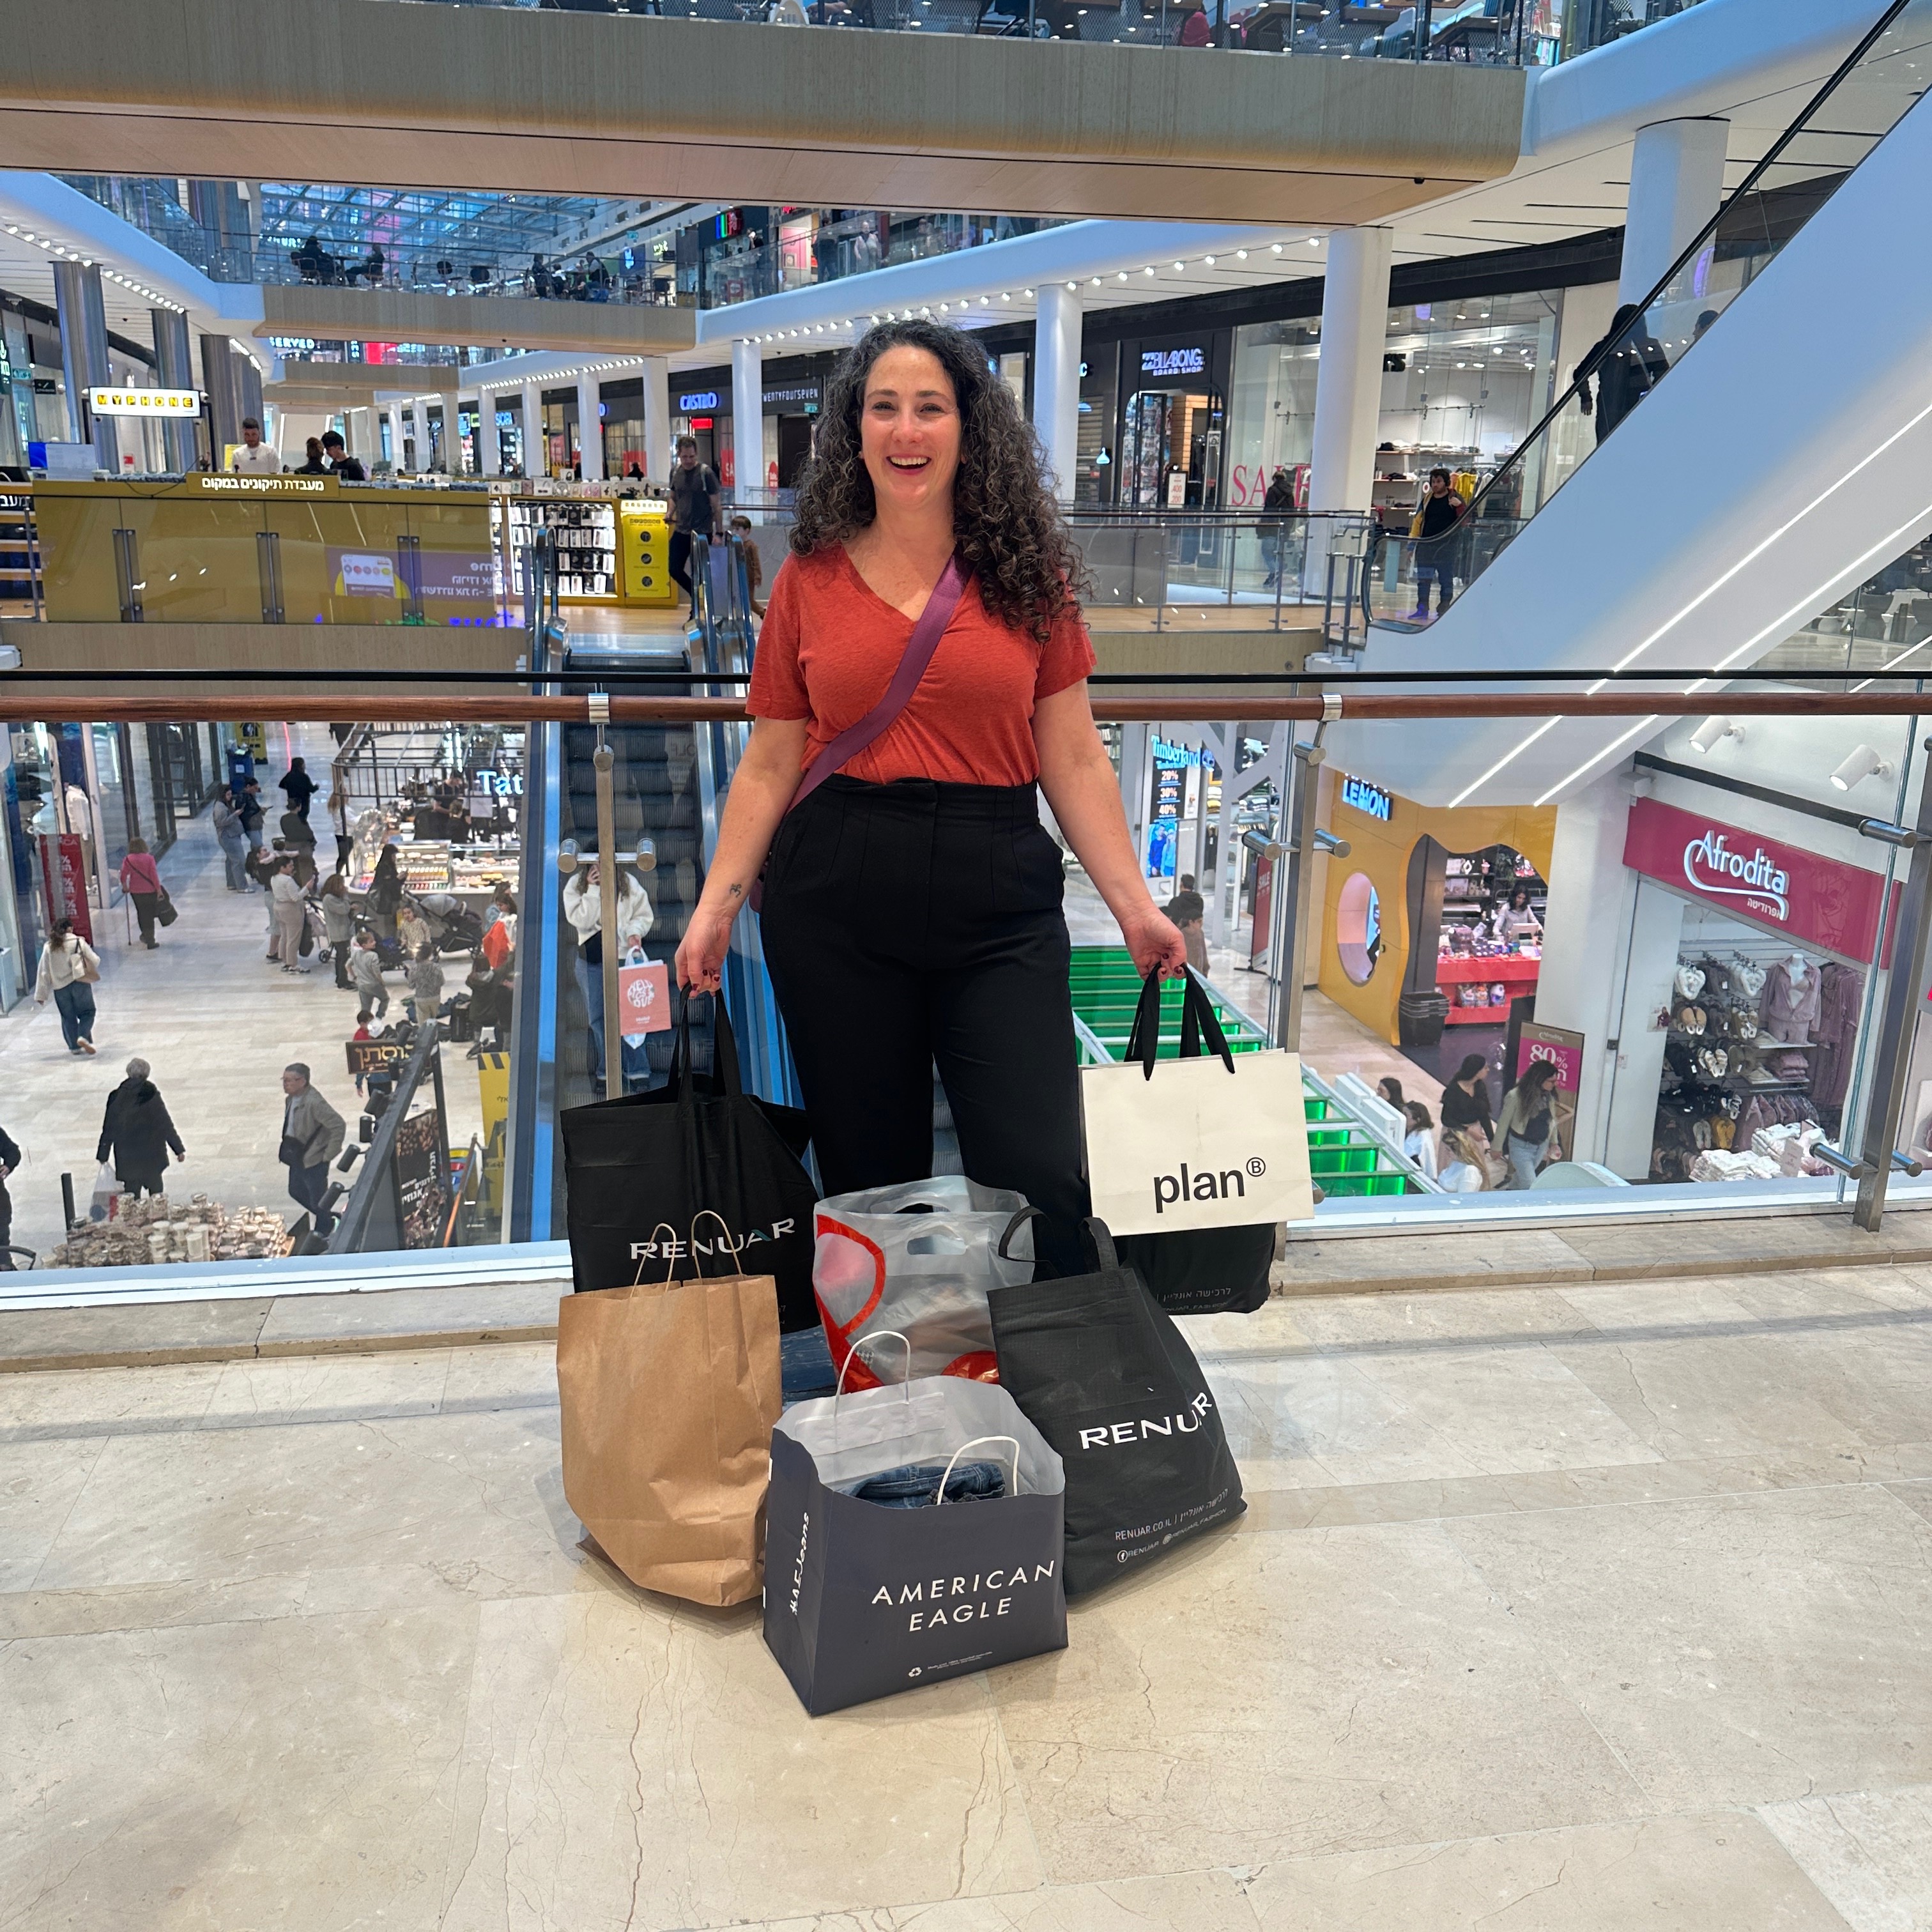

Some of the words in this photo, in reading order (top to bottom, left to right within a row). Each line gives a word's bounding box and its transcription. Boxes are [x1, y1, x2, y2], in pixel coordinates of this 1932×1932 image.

[97, 394, 193, 408] MYPHONE
[201, 477, 240, 491] במקום
[240, 478, 282, 491] תיקונים
[284, 480, 325, 491] מעבדת
[1231, 464, 1312, 507] SAE
[1151, 734, 1202, 767] Timberland
[1342, 779, 1390, 822] LEMON
[1684, 830, 1789, 894] Afrodita
[629, 1217, 795, 1260] RENUAR
[1196, 1287, 1232, 1298] לרכישה
[1078, 1392, 1213, 1450] RENUR
[871, 1560, 1055, 1606] AMERICAN
[909, 1597, 1012, 1632] EAGLE
